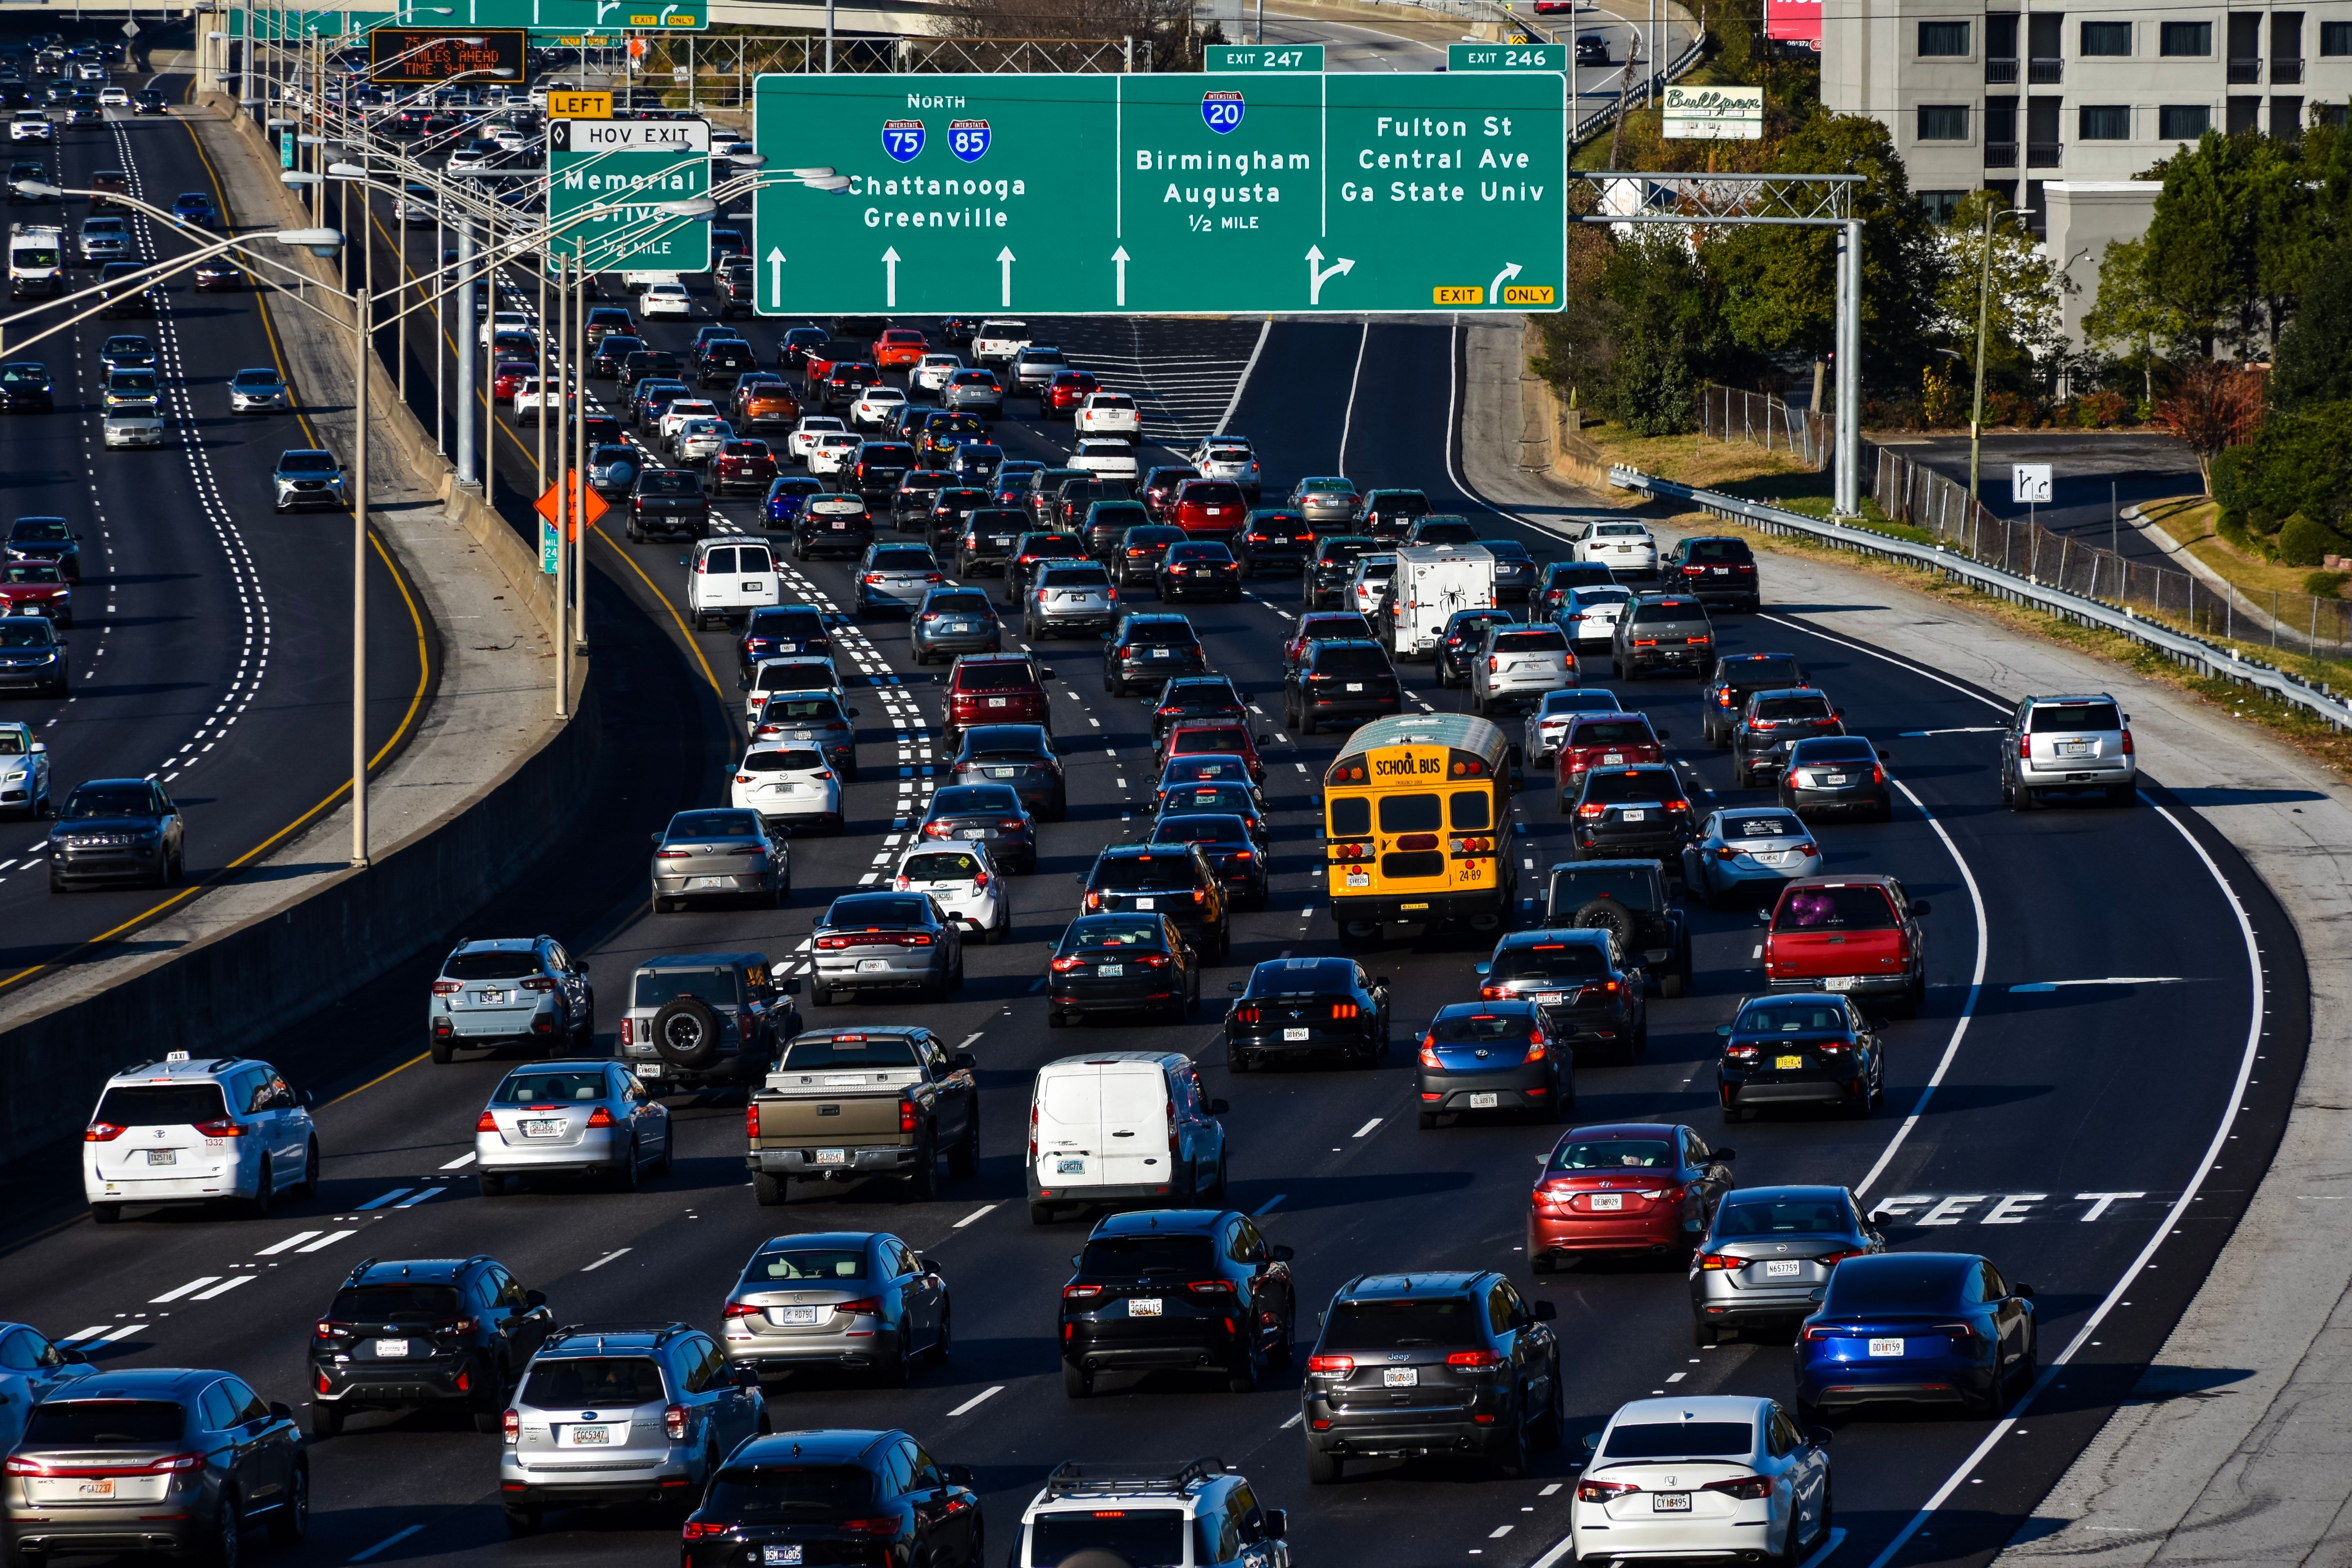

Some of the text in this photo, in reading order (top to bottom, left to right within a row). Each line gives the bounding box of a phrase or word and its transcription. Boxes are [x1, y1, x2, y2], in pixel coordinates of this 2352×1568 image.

[414, 50, 450, 62] MILES
[459, 50, 498, 62] AHEAD
[1227, 52, 1302, 67] EXIT 247
[1468, 51, 1546, 66] EXIT 246
[556, 98, 604, 112] LEFT
[908, 94, 965, 108] NORTH
[1667, 89, 1761, 116] Bullpen
[1210, 105, 1239, 124] 20
[1378, 116, 1512, 137] Fulton St
[590, 128, 689, 143] HOV EXIT
[890, 132, 917, 152] 75
[956, 132, 983, 152] 85
[1137, 150, 1310, 176] Birmingham
[1359, 149, 1529, 169] Central Ave
[565, 171, 694, 190] Memorial
[849, 175, 1025, 201] Chattanooga
[1164, 183, 1279, 209] Augusta
[1342, 182, 1544, 202] Ga State Univ
[593, 202, 665, 222] Drive
[865, 207, 1007, 227] Greenville
[1222, 216, 1259, 229] MILE
[634, 242, 671, 254] MILE
[1440, 289, 1550, 301] EXIT ONLY
[545, 548, 557, 558] 24
[1376, 758, 1440, 775] SCHOOL BUS
[1459, 869, 1481, 881] 24-89
[1868, 1192, 2146, 1226] FEET
[1769, 1264, 1797, 1272] N657759
[795, 1310, 813, 1319] RD790
[1388, 1353, 1410, 1361] Jeep
[577, 1430, 604, 1440] CGC5347
[87, 1484, 111, 1493] GAZ237
[766, 1550, 778, 1560] BSM
[784, 1550, 800, 1559] 4805
